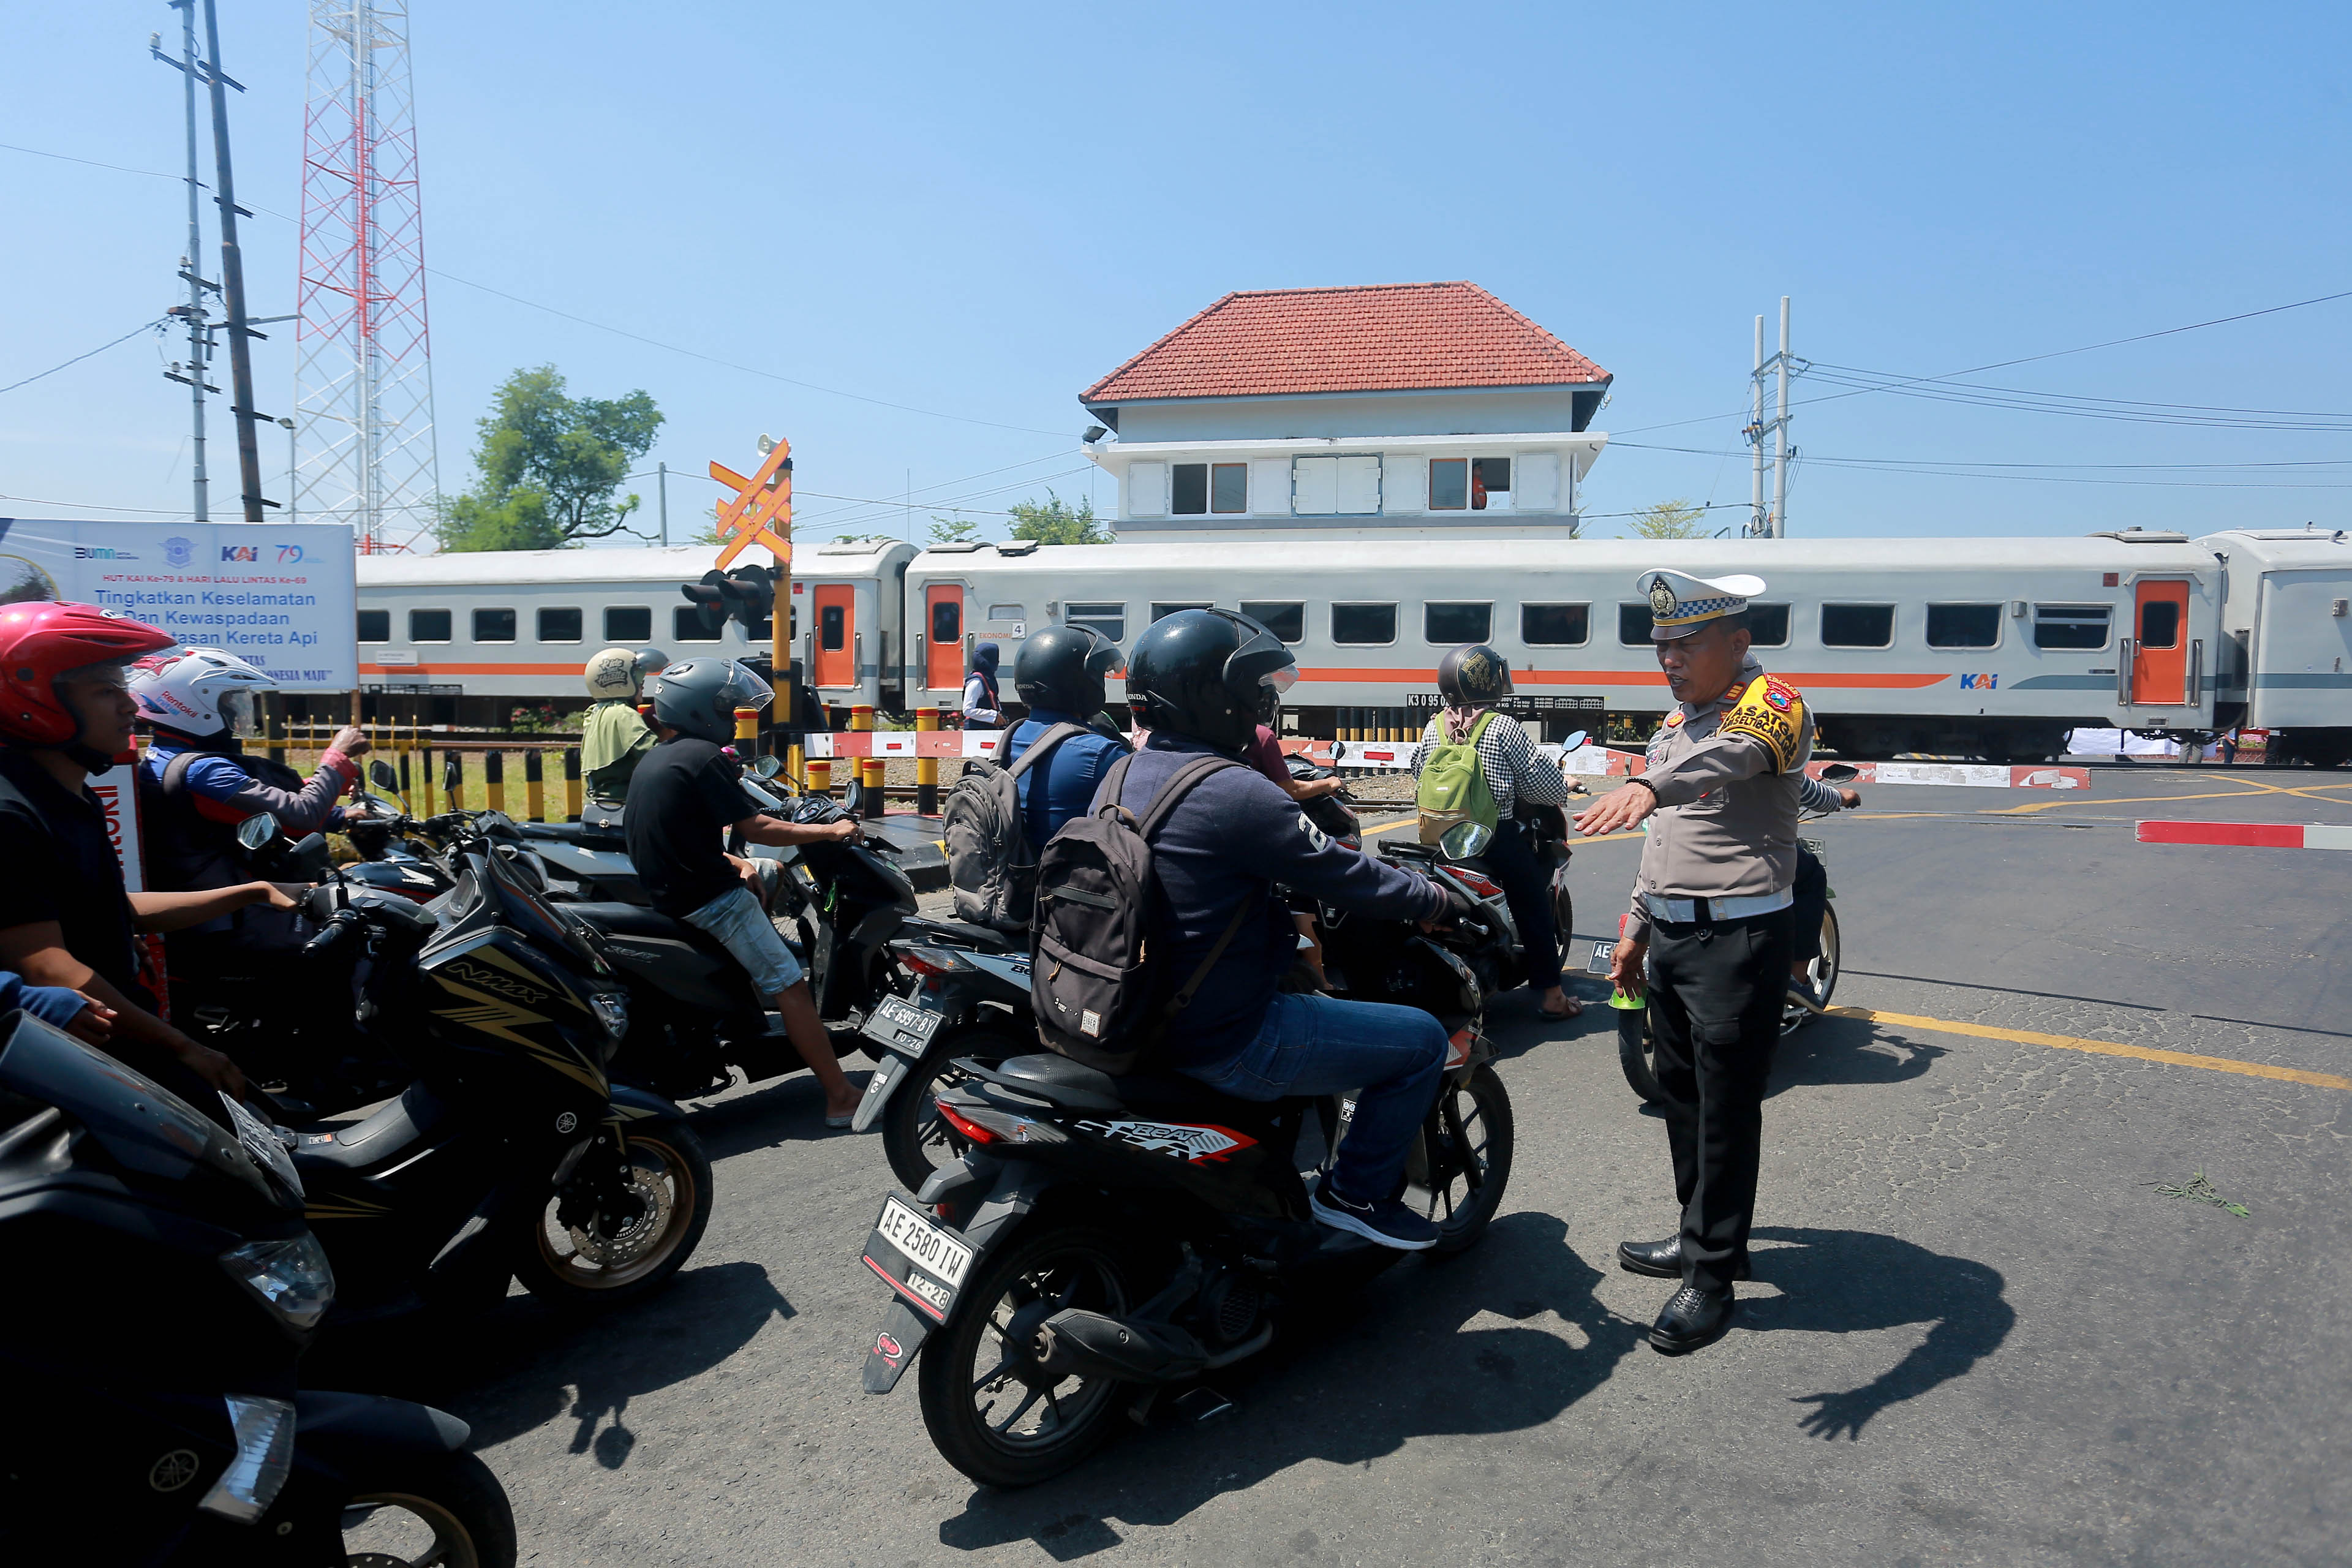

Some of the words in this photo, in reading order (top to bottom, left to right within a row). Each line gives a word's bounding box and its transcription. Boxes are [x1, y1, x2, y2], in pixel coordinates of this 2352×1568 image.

[221, 546, 258, 562] KAI
[274, 545, 303, 564] 79
[94, 590, 195, 607] Tingkatkan
[202, 592, 315, 606] Keselamatan
[124, 610, 159, 624] Dan
[166, 611, 290, 627] Kewaspadaan
[1014, 625, 1022, 634] 4
[227, 631, 283, 644] Kereta
[288, 631, 317, 647] Api
[1960, 674, 1998, 690] KAI
[162, 691, 198, 718] Rentokil
[1408, 695, 1419, 706] K3
[1428, 695, 1439, 706] 95
[1594, 944, 1612, 959] AE
[880, 1001, 894, 1017] AE
[894, 1008, 919, 1028] 6997
[918, 1017, 935, 1034] BY
[1083, 1016, 1096, 1030] EIGER
[1131, 1124, 1204, 1142] BeAT
[884, 1208, 906, 1238] AE
[903, 1222, 941, 1262] 2580
[938, 1246, 965, 1279] IW
